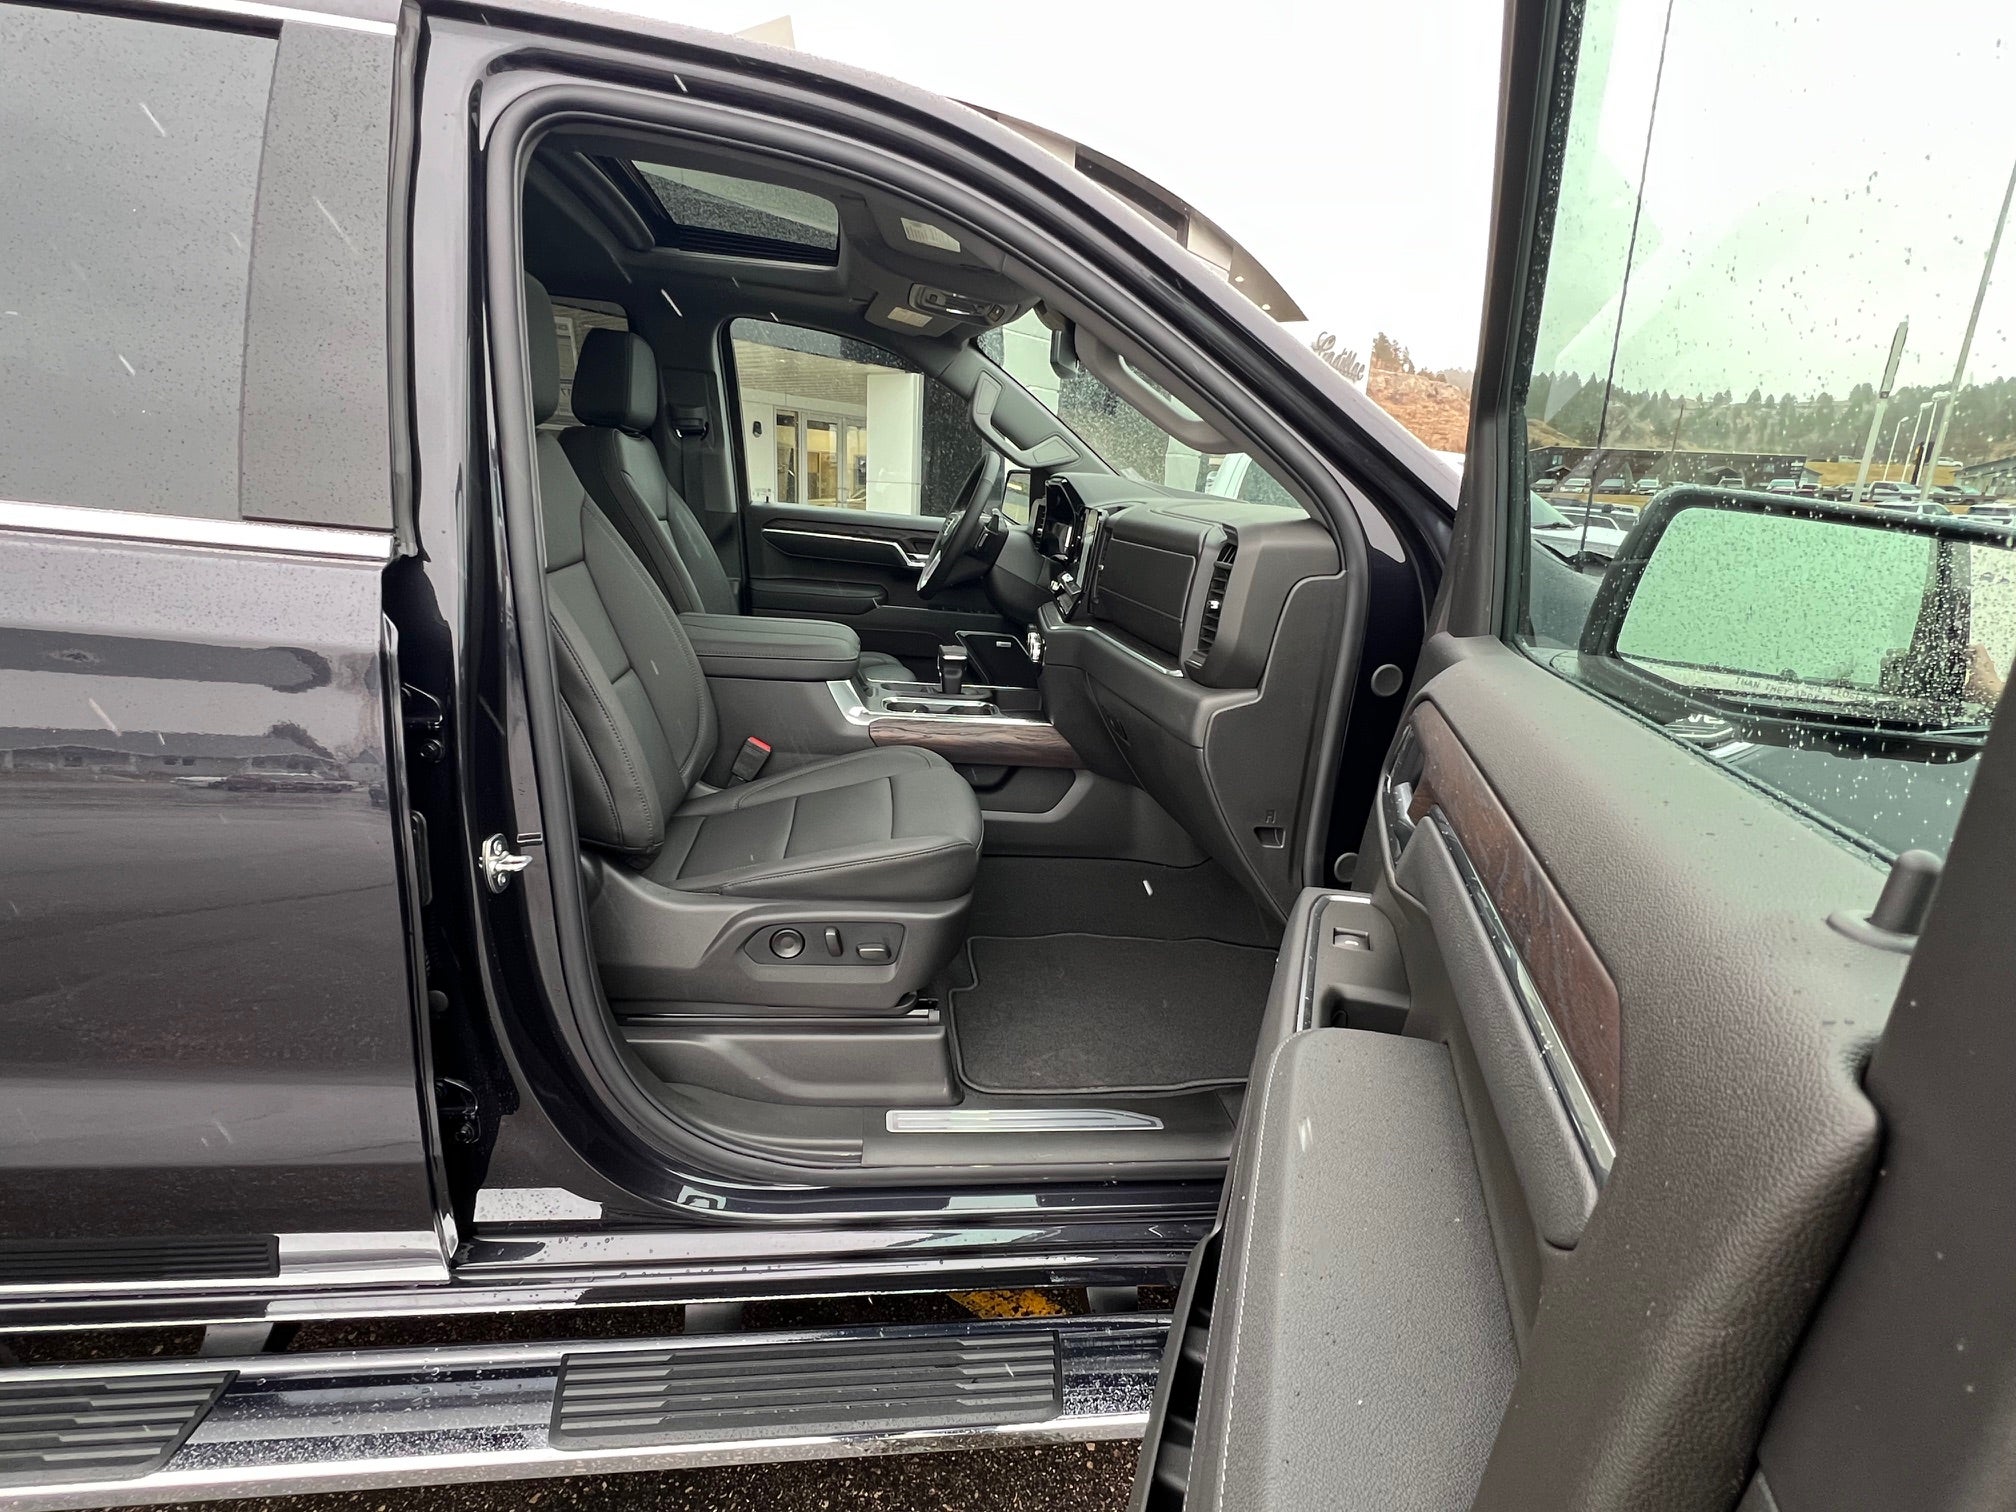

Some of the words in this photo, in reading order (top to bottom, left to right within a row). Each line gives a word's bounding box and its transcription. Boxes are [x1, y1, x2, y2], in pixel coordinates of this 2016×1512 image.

[1311, 331, 1365, 382] Cadillac
[1736, 677, 1760, 688] THAN
[1765, 683, 1791, 695] THEY
